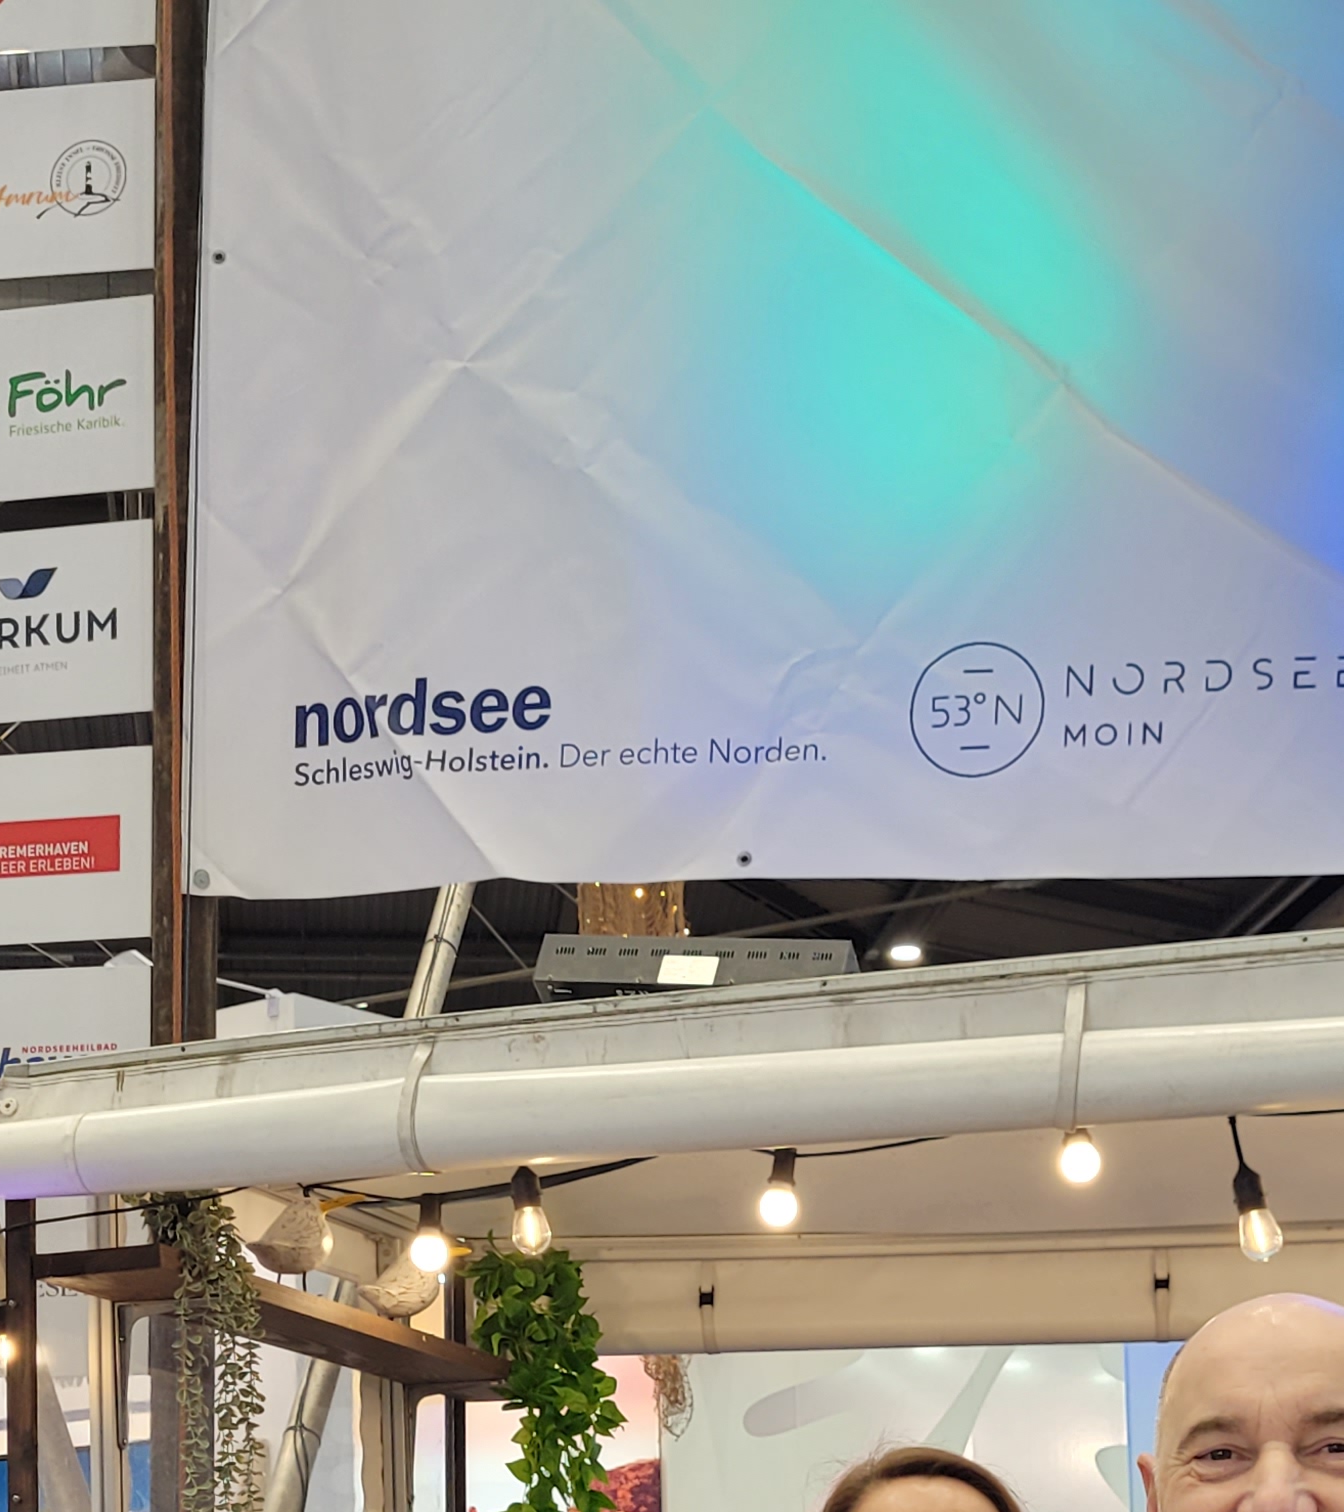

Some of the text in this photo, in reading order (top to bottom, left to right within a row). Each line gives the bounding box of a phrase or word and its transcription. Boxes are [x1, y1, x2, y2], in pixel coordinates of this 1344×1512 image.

[8, 369, 127, 418] Föhr
[9, 421, 72, 438] Friesische
[33, 661, 68, 673] ATMEN
[294, 677, 552, 748] nordsee
[1063, 721, 1165, 748] MOIN
[293, 736, 828, 787] Schleswig-Holstein. Der echte Norden.
[29, 857, 95, 873] ERLEBEN!
[22, 1043, 118, 1055] NORDSEEHEILBAD
